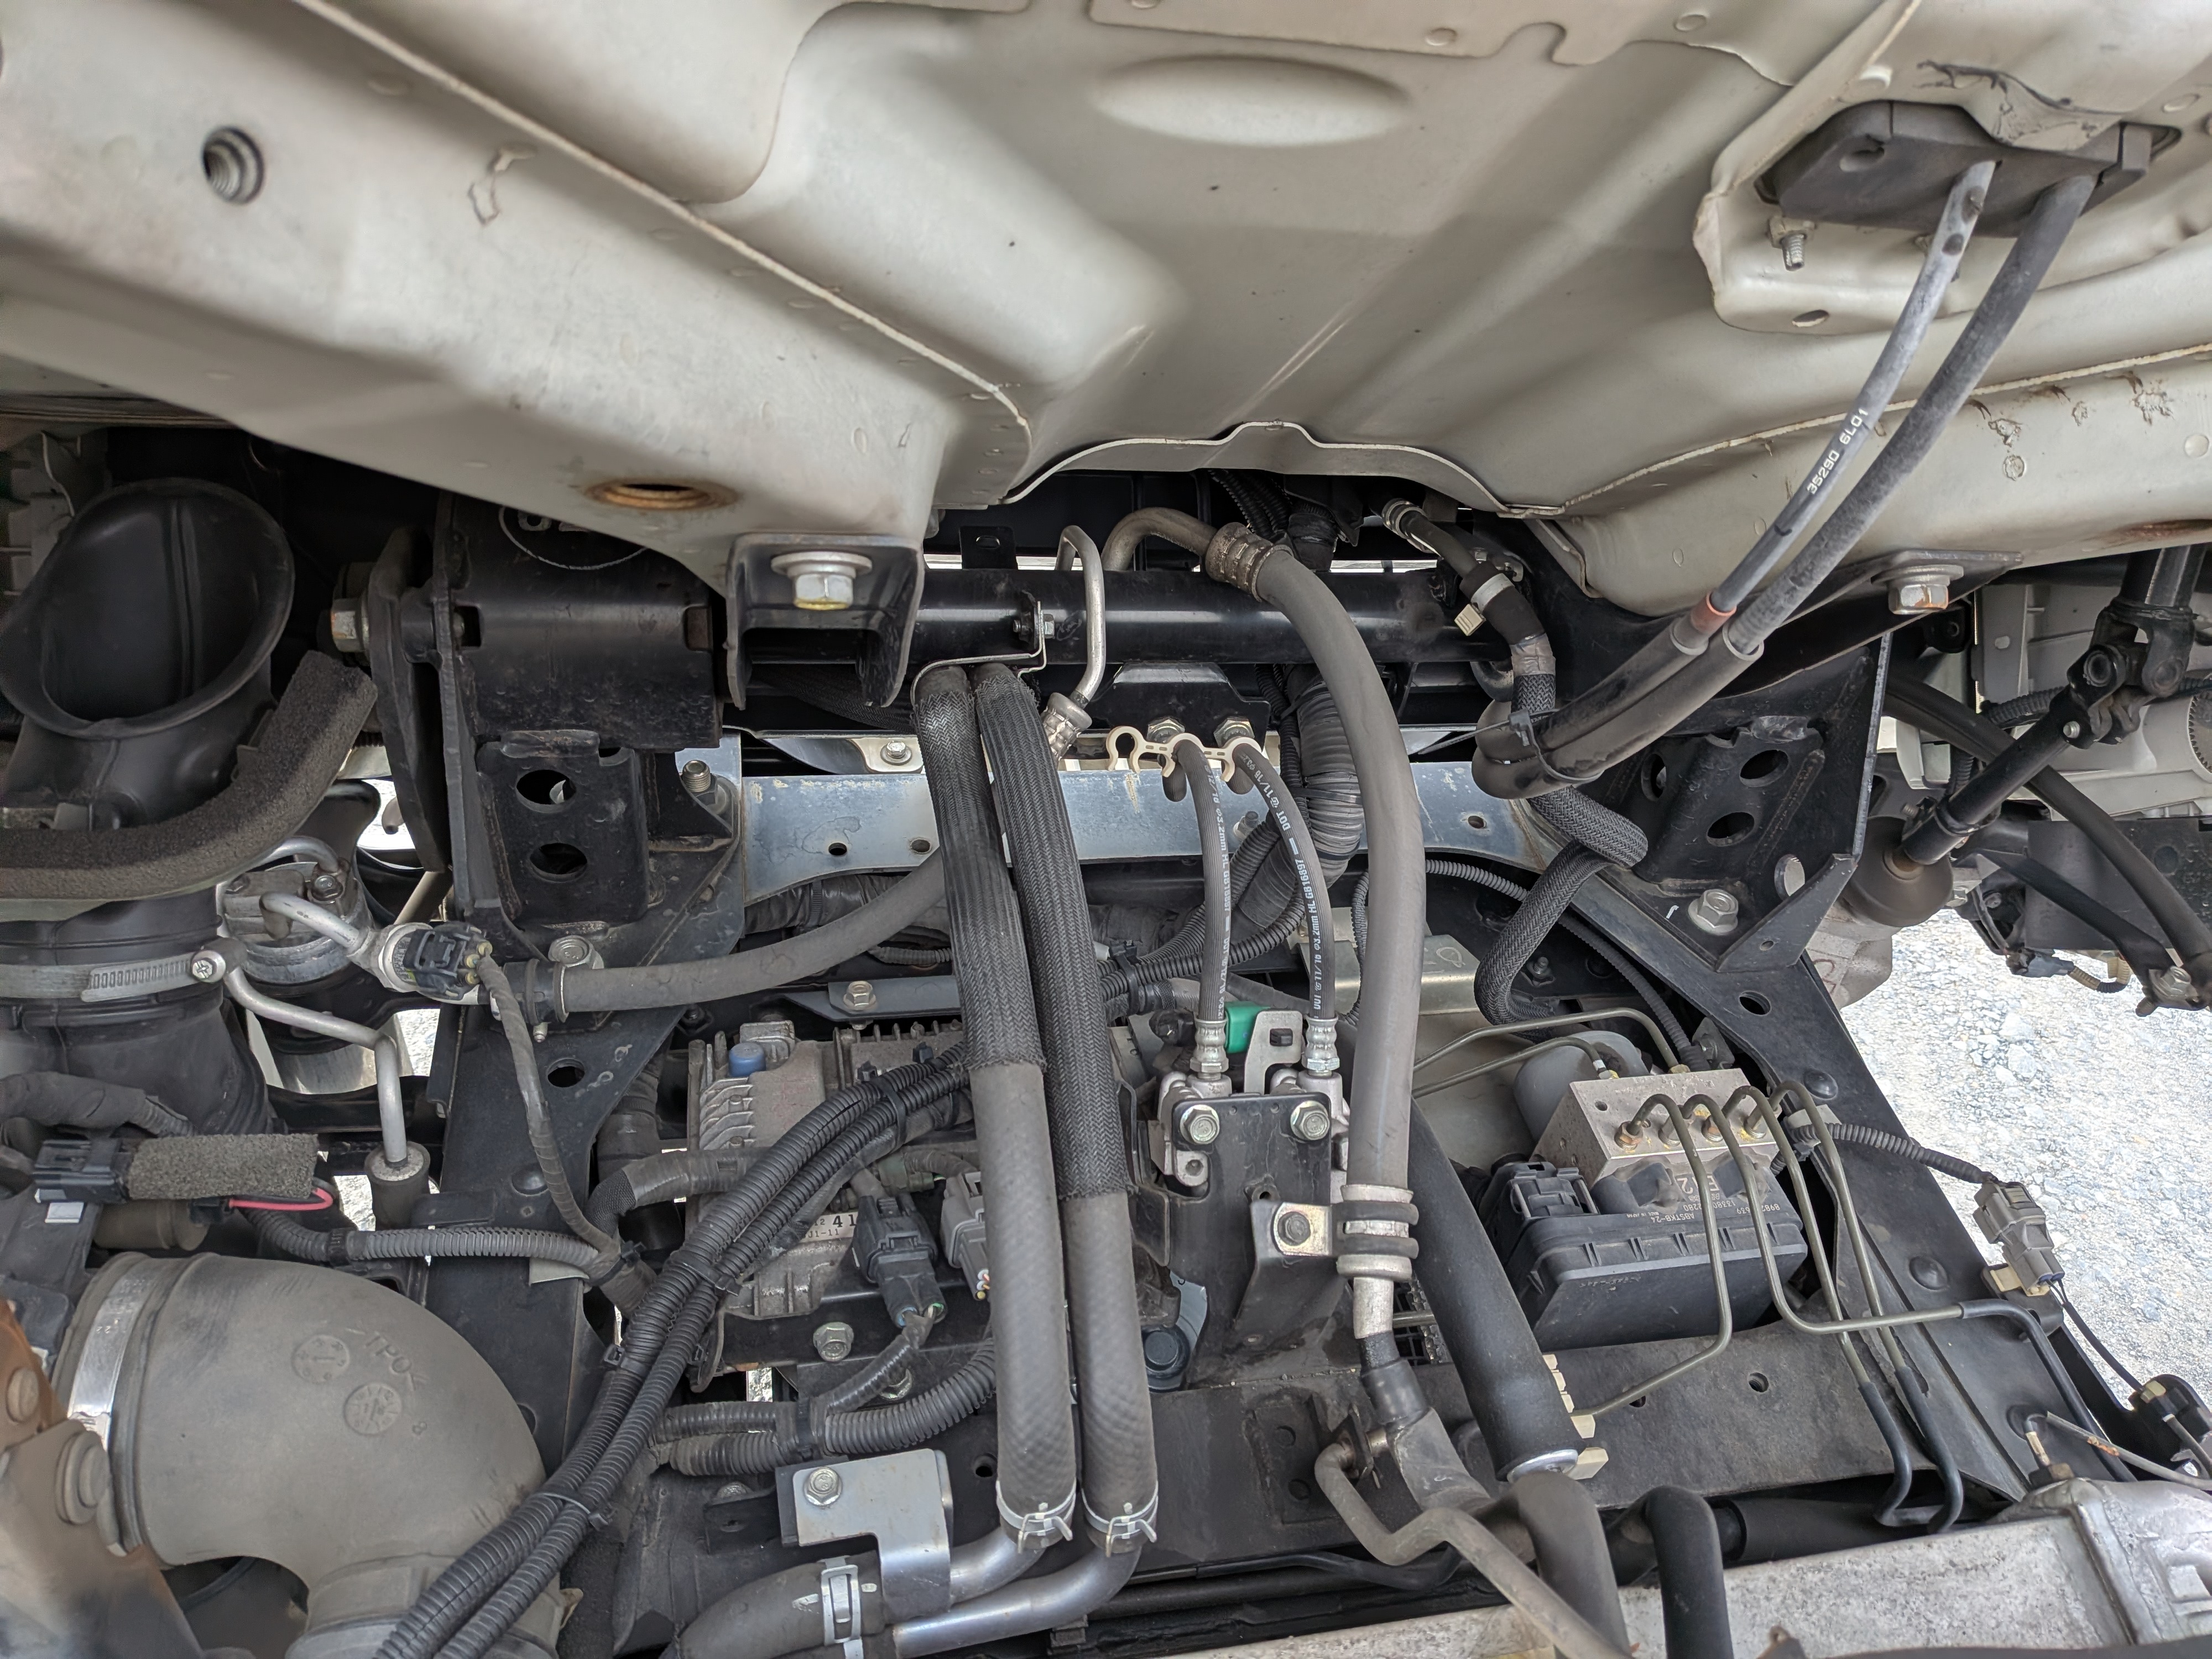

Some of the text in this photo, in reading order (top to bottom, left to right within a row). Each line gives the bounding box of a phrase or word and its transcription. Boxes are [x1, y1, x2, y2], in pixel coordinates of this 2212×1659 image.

[1807, 408, 1869, 494] 35290 6L01
[1276, 811, 1291, 831] DOT
[1222, 854, 1228, 868] HL
[1295, 859, 1313, 899] GB16897
[1307, 900, 1317, 913] HL
[1651, 1213, 1694, 1223] ABSTKB-24
[804, 1229, 839, 1239] J1-11
